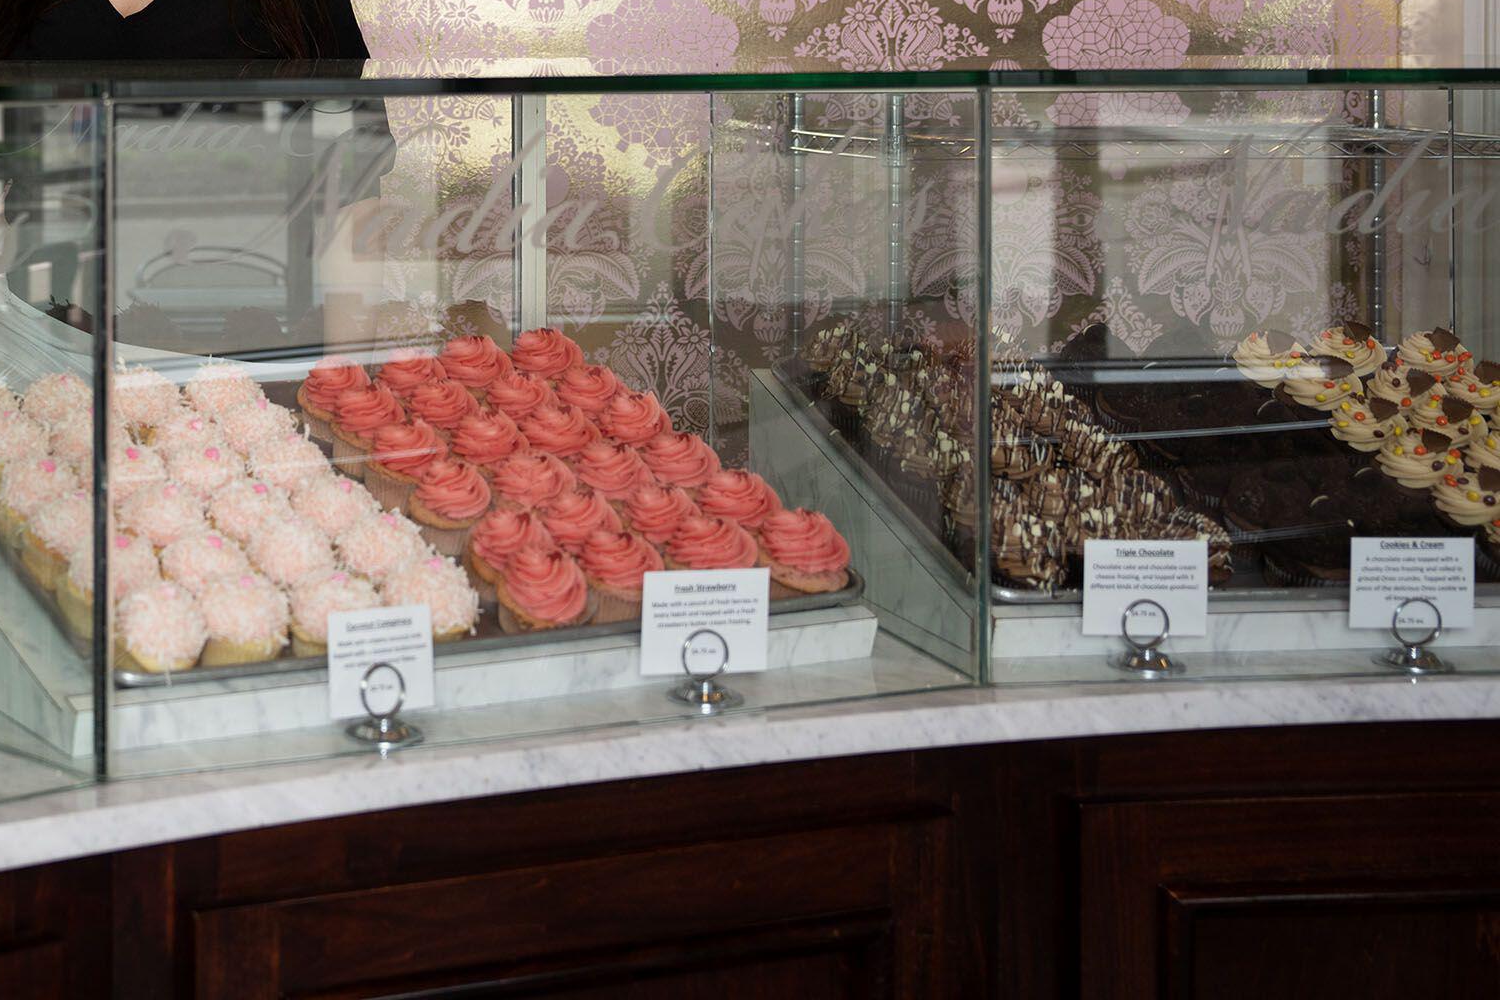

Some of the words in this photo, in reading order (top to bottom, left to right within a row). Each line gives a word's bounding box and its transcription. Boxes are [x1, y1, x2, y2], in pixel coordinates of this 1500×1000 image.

[1380, 541, 1410, 550] Cookies
[1420, 541, 1445, 550] Cream
[1116, 548, 1137, 558] Triple
[1139, 548, 1175, 557] Chocolate
